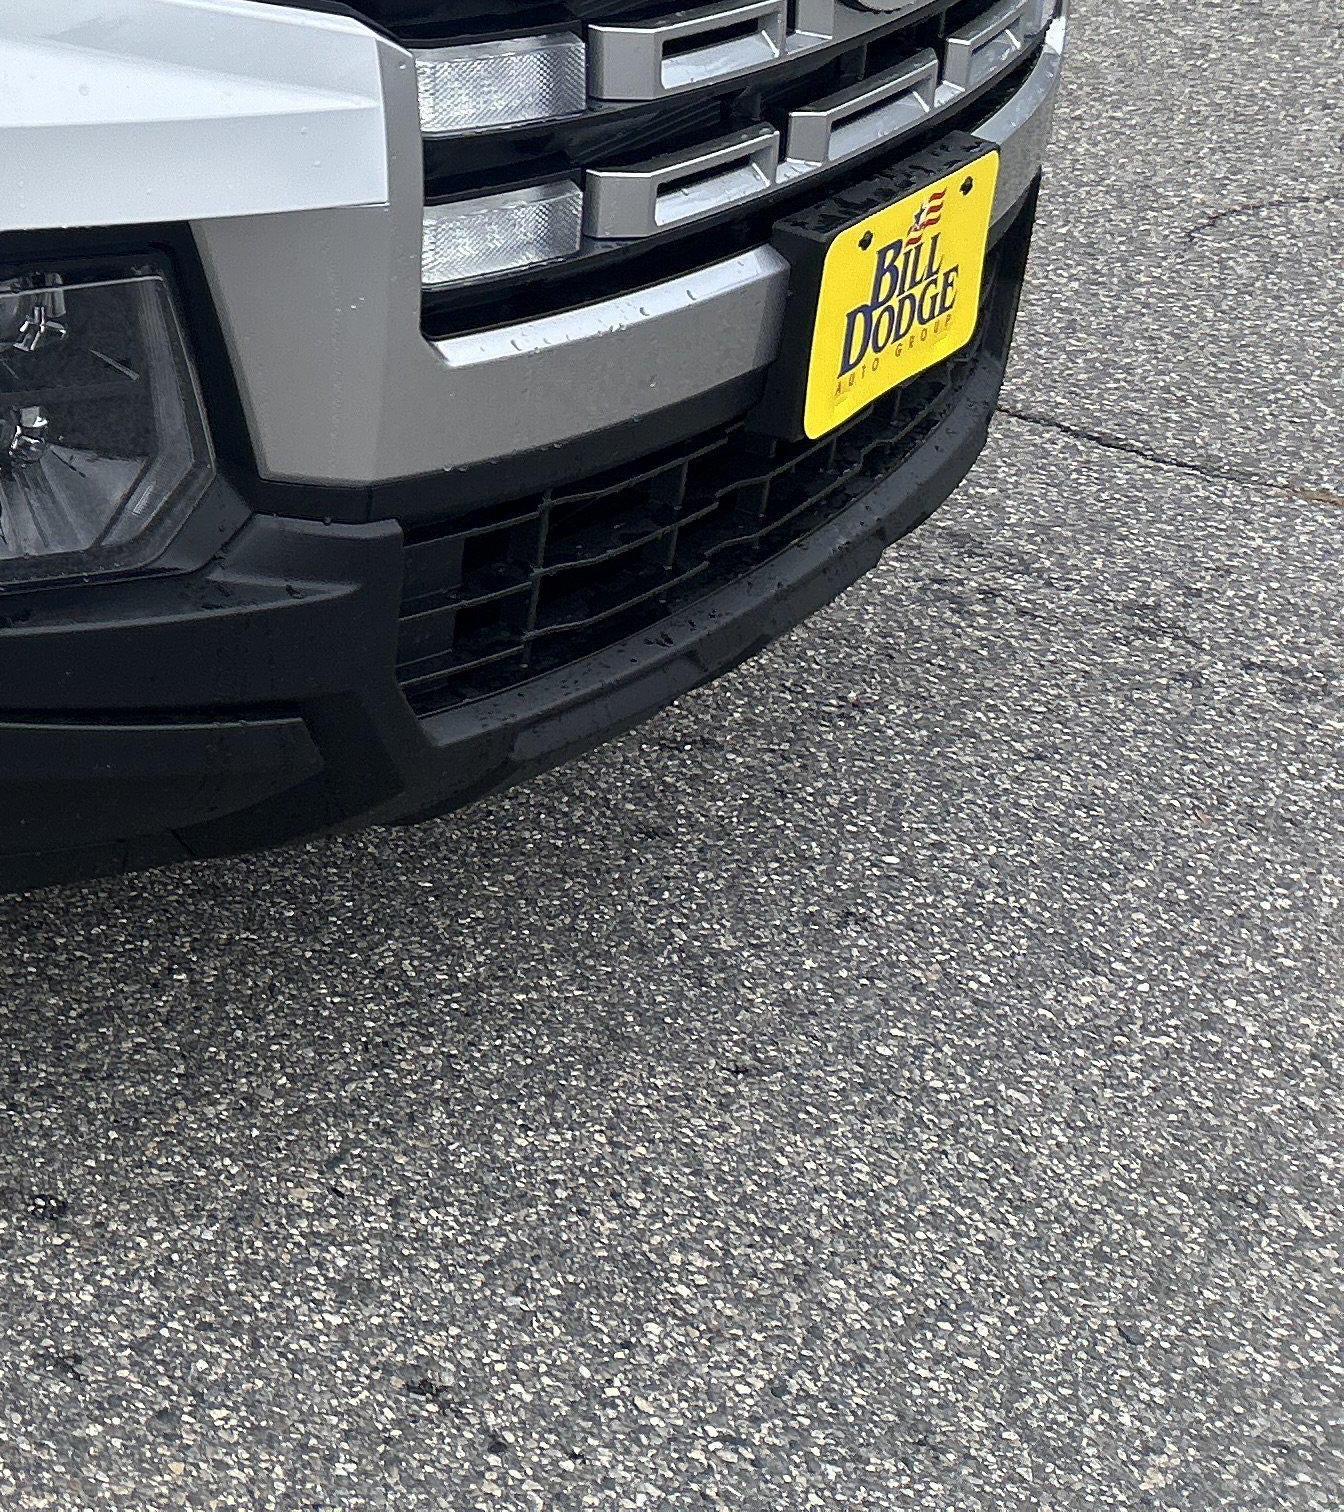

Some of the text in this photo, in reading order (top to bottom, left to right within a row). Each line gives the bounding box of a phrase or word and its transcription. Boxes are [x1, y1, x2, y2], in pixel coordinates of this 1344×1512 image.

[870, 232, 945, 307] BILL
[834, 314, 953, 398] AUTO GROUP
[837, 264, 959, 379] DODGE
